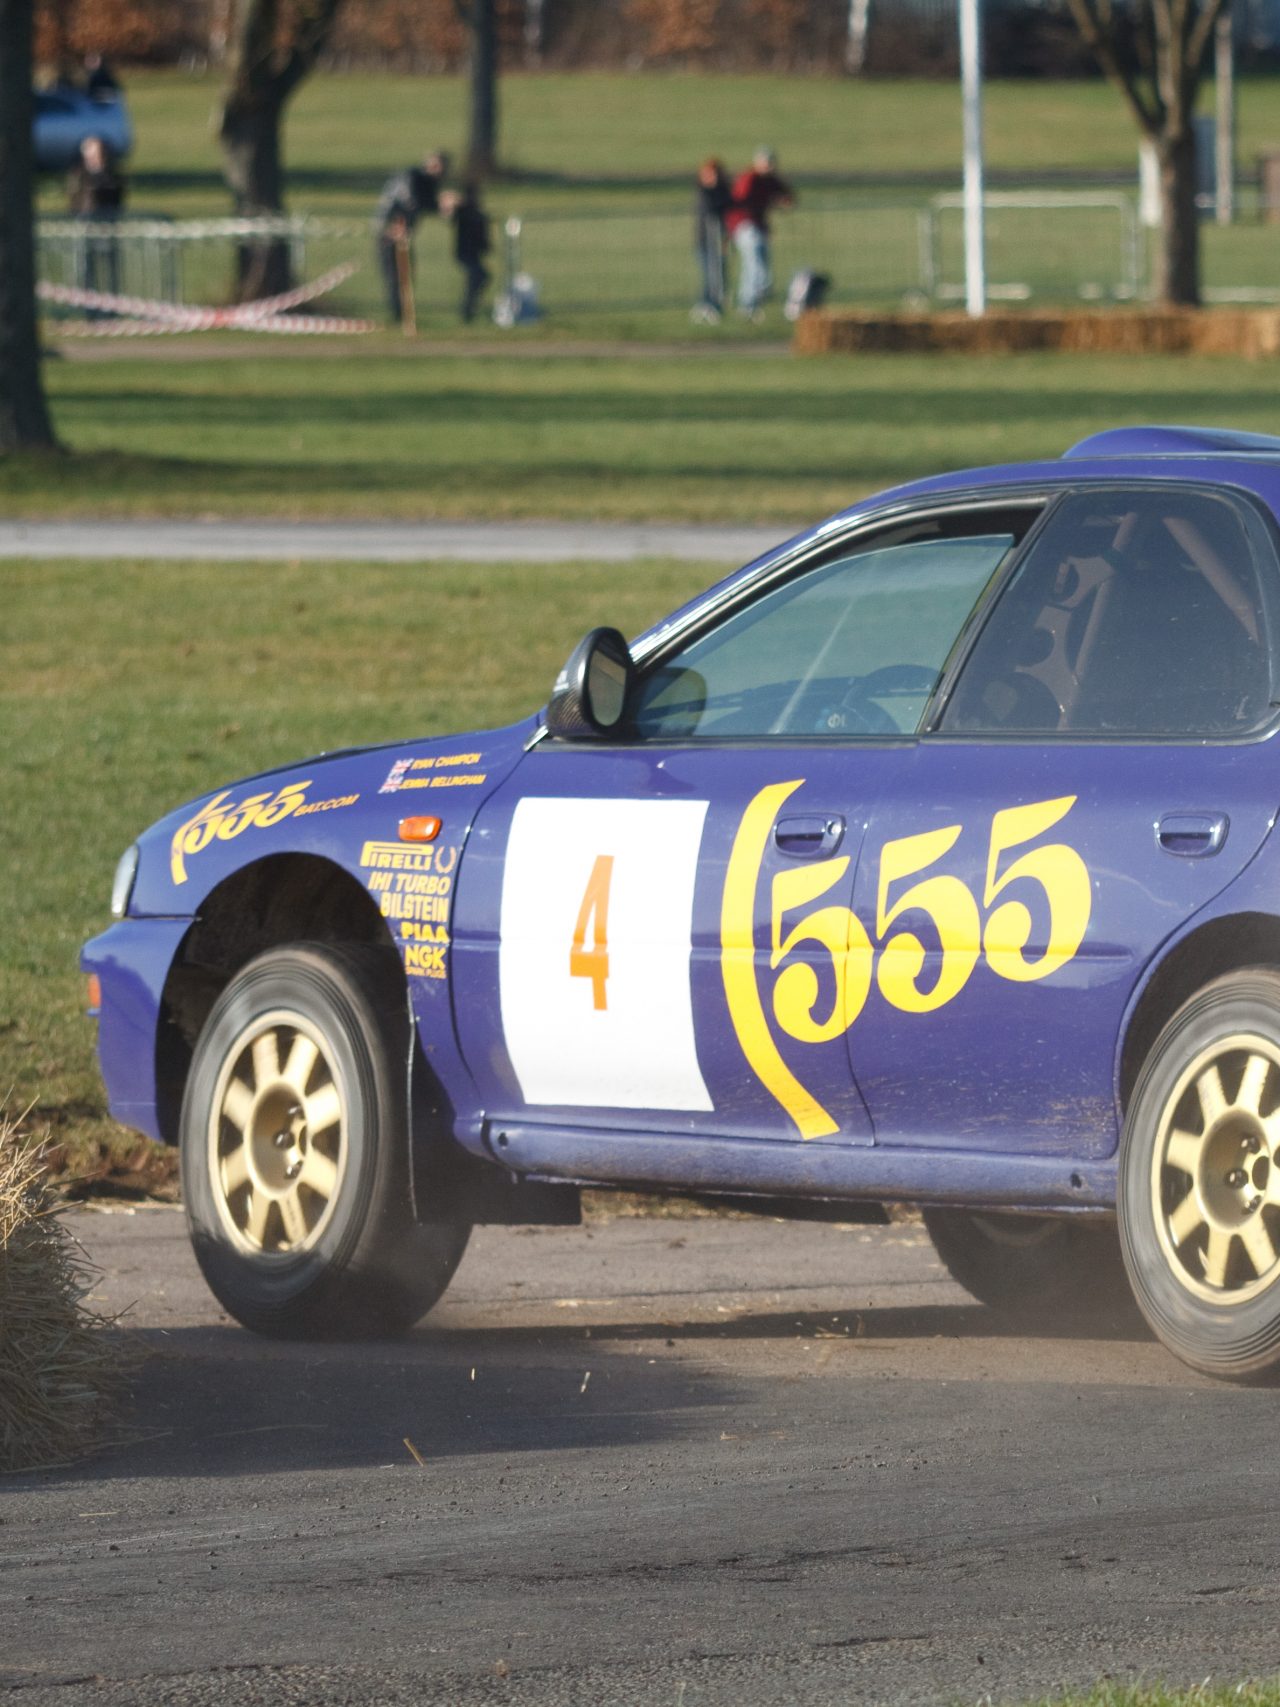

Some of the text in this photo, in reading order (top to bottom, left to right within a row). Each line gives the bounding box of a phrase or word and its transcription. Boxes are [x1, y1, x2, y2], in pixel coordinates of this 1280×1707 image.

[435, 753, 482, 768] CHAMPION
[360, 841, 435, 871] PIRELLI
[367, 871, 451, 896] IHI TURBO
[380, 891, 449, 922] BILSTEIN
[770, 795, 1093, 1044] 555
[401, 921, 450, 944] PIAA
[570, 855, 615, 1011] 4
[405, 944, 446, 969] NGK
